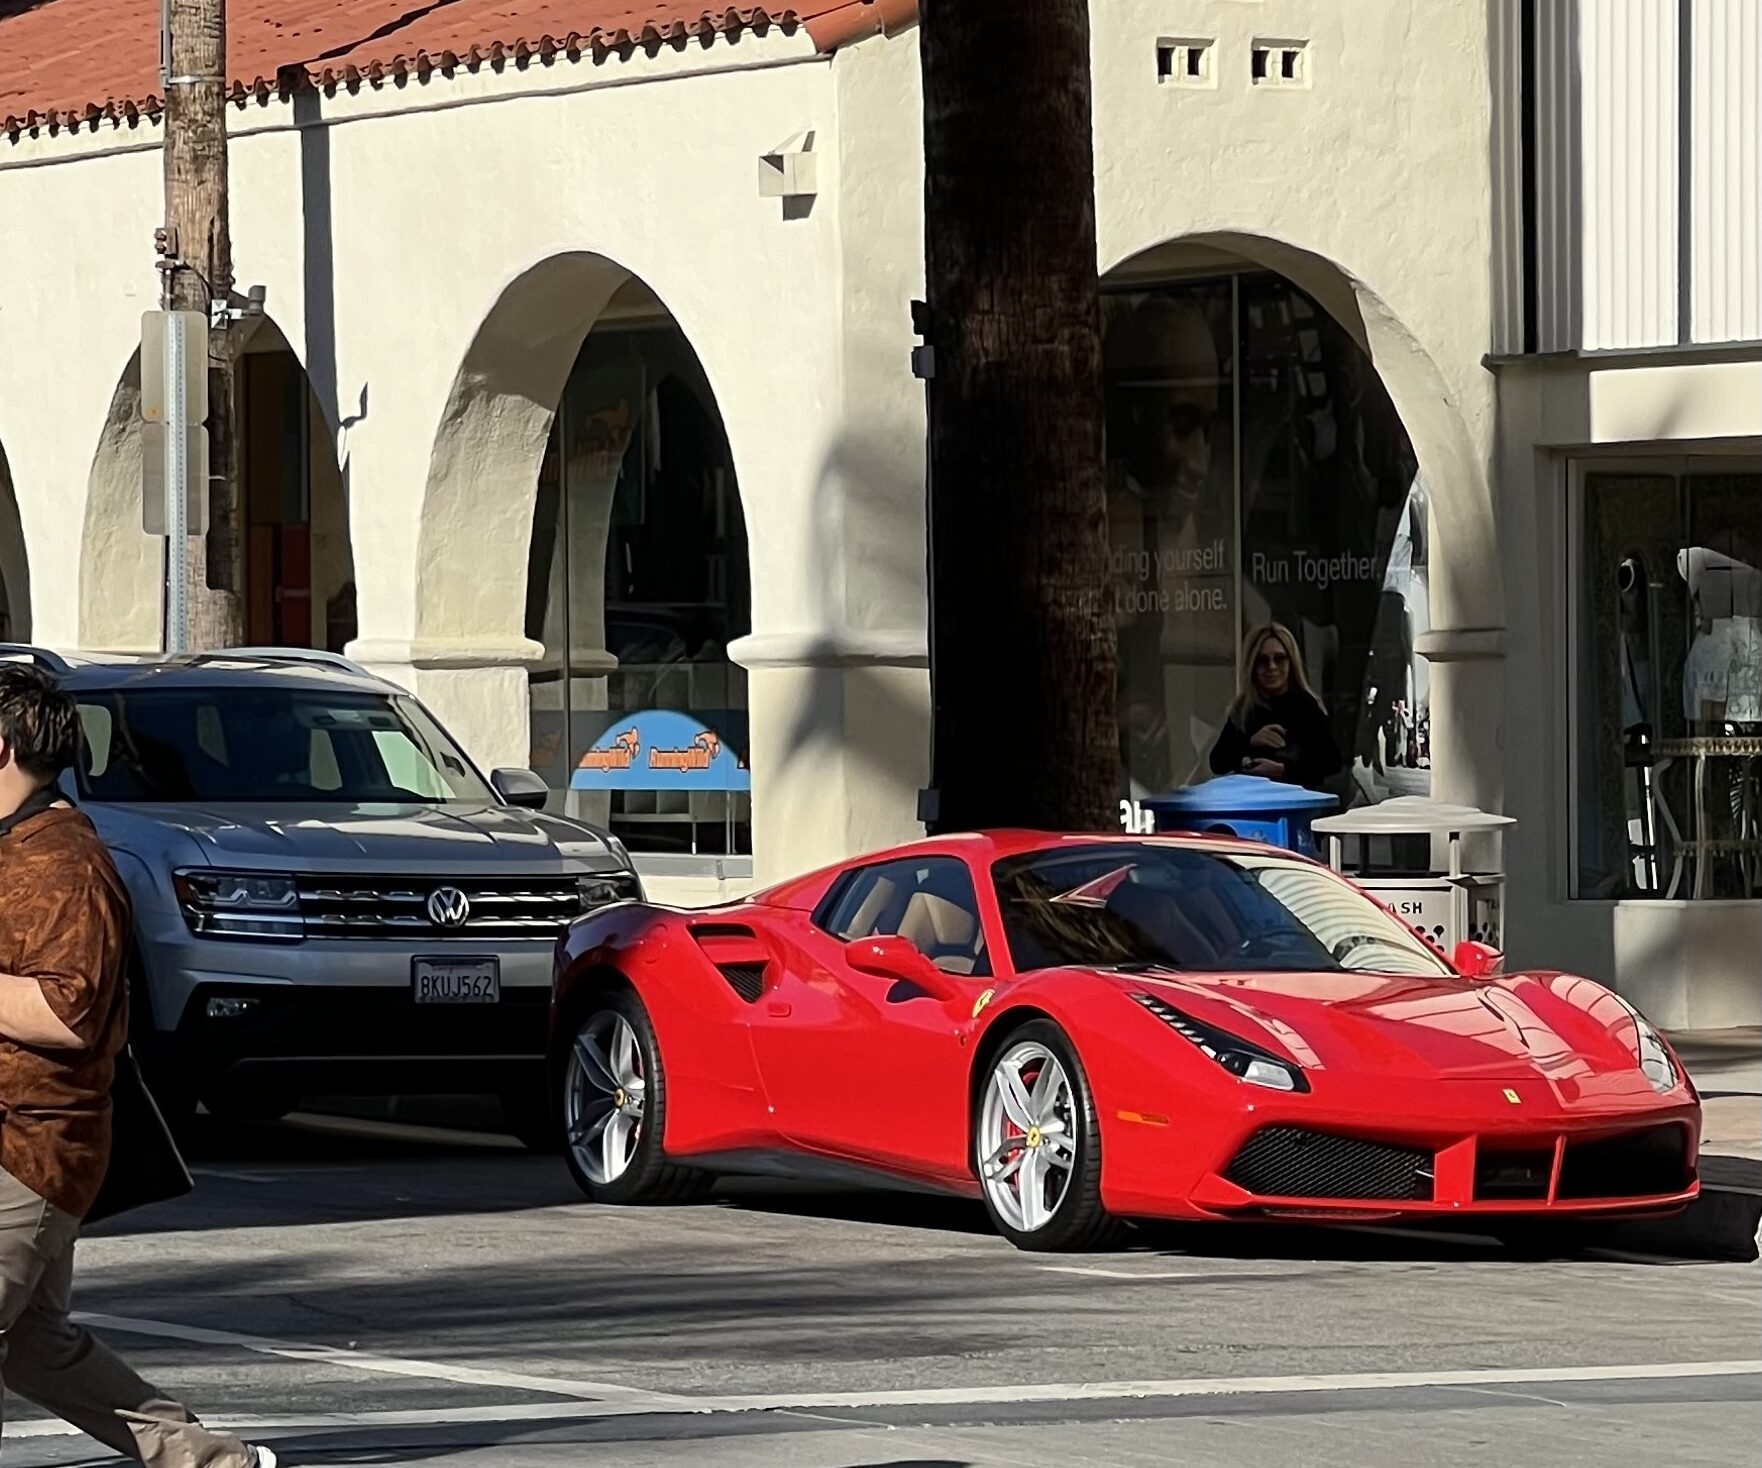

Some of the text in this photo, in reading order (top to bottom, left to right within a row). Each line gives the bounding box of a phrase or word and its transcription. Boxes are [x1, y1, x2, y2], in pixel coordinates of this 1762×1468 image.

[1154, 538, 1226, 581] yourself
[1252, 552, 1289, 584] Run
[1125, 583, 1170, 613] done
[1175, 580, 1228, 612] alone.
[420, 975, 495, 997] 8KUJ562
